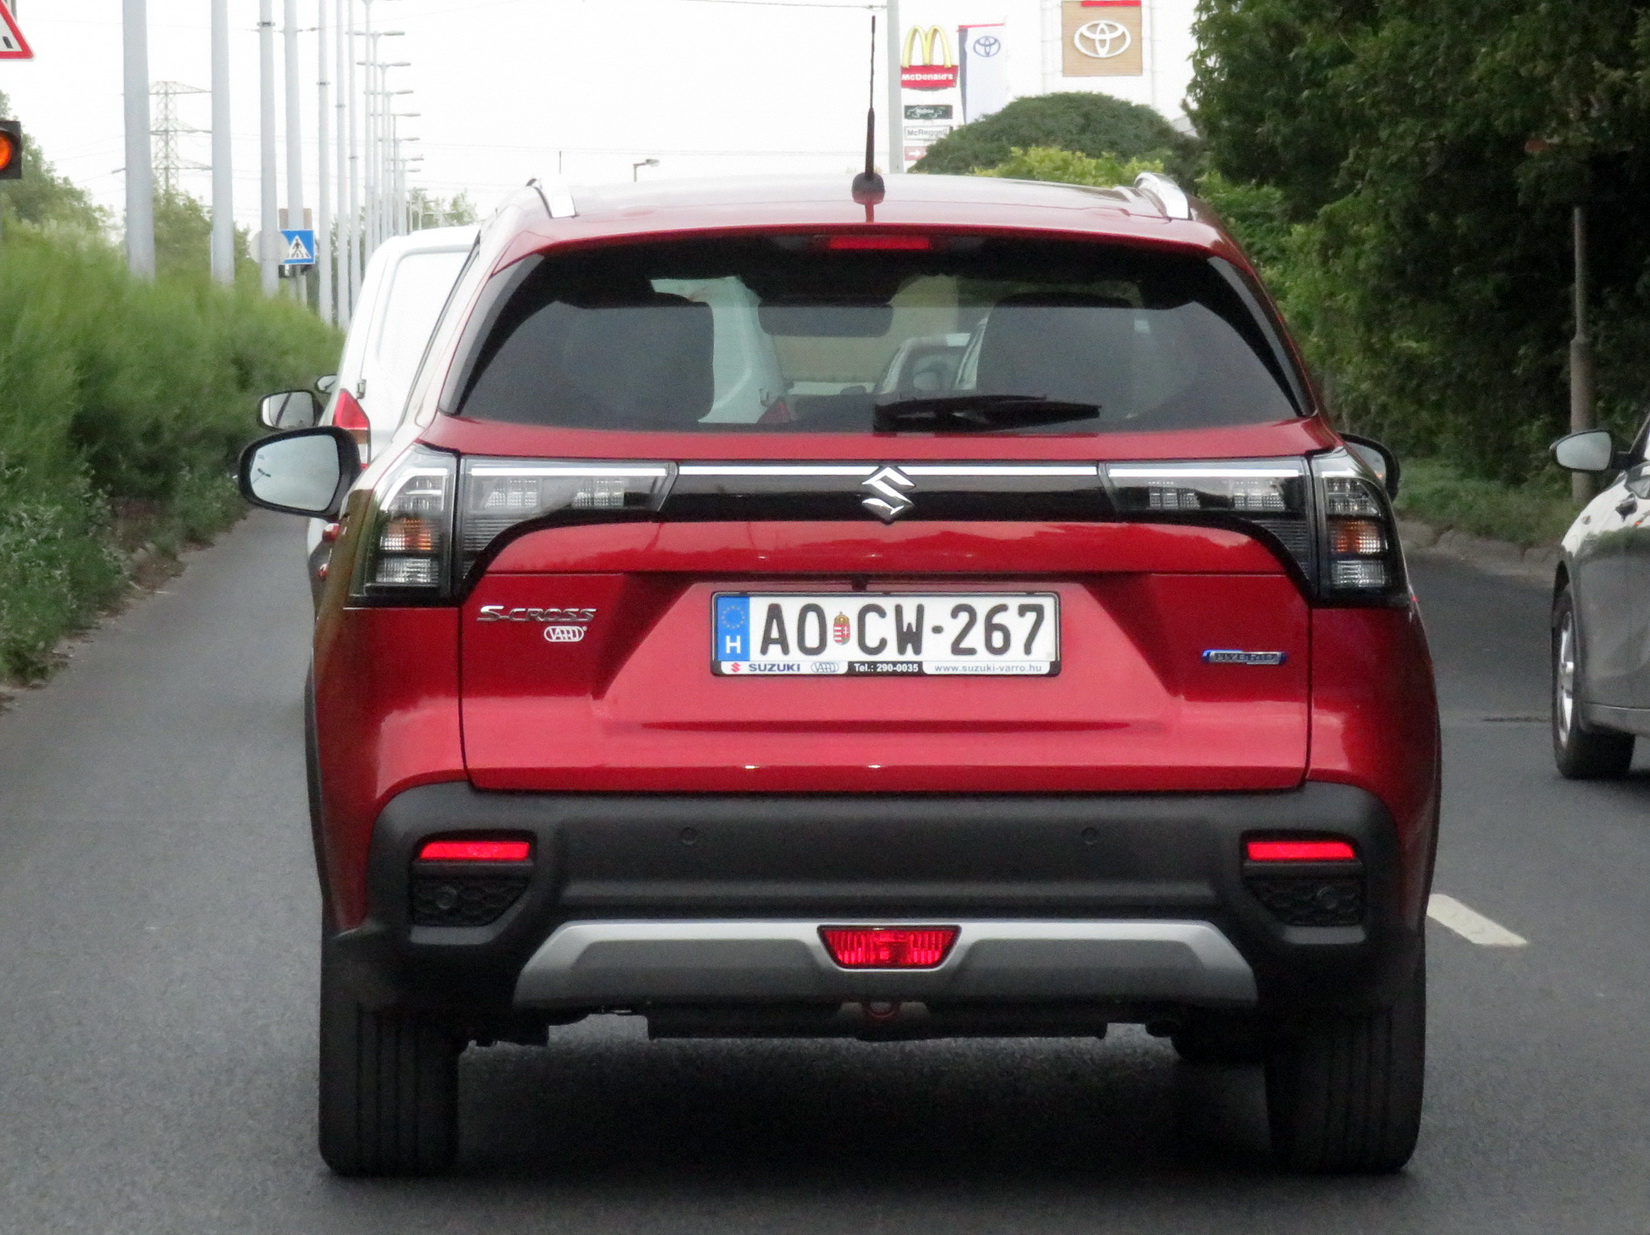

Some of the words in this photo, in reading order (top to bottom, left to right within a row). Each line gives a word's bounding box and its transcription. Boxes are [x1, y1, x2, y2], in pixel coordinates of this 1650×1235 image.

[477, 605, 597, 622] S-CROSS
[759, 603, 828, 656] AO
[857, 603, 1046, 656] CW-267
[725, 635, 742, 654] H
[748, 663, 800, 672] SUZUKI
[853, 663, 874, 672] Tel.:
[876, 663, 919, 672] 290-0035
[934, 663, 1042, 673] www.suzuki-varro.hu
